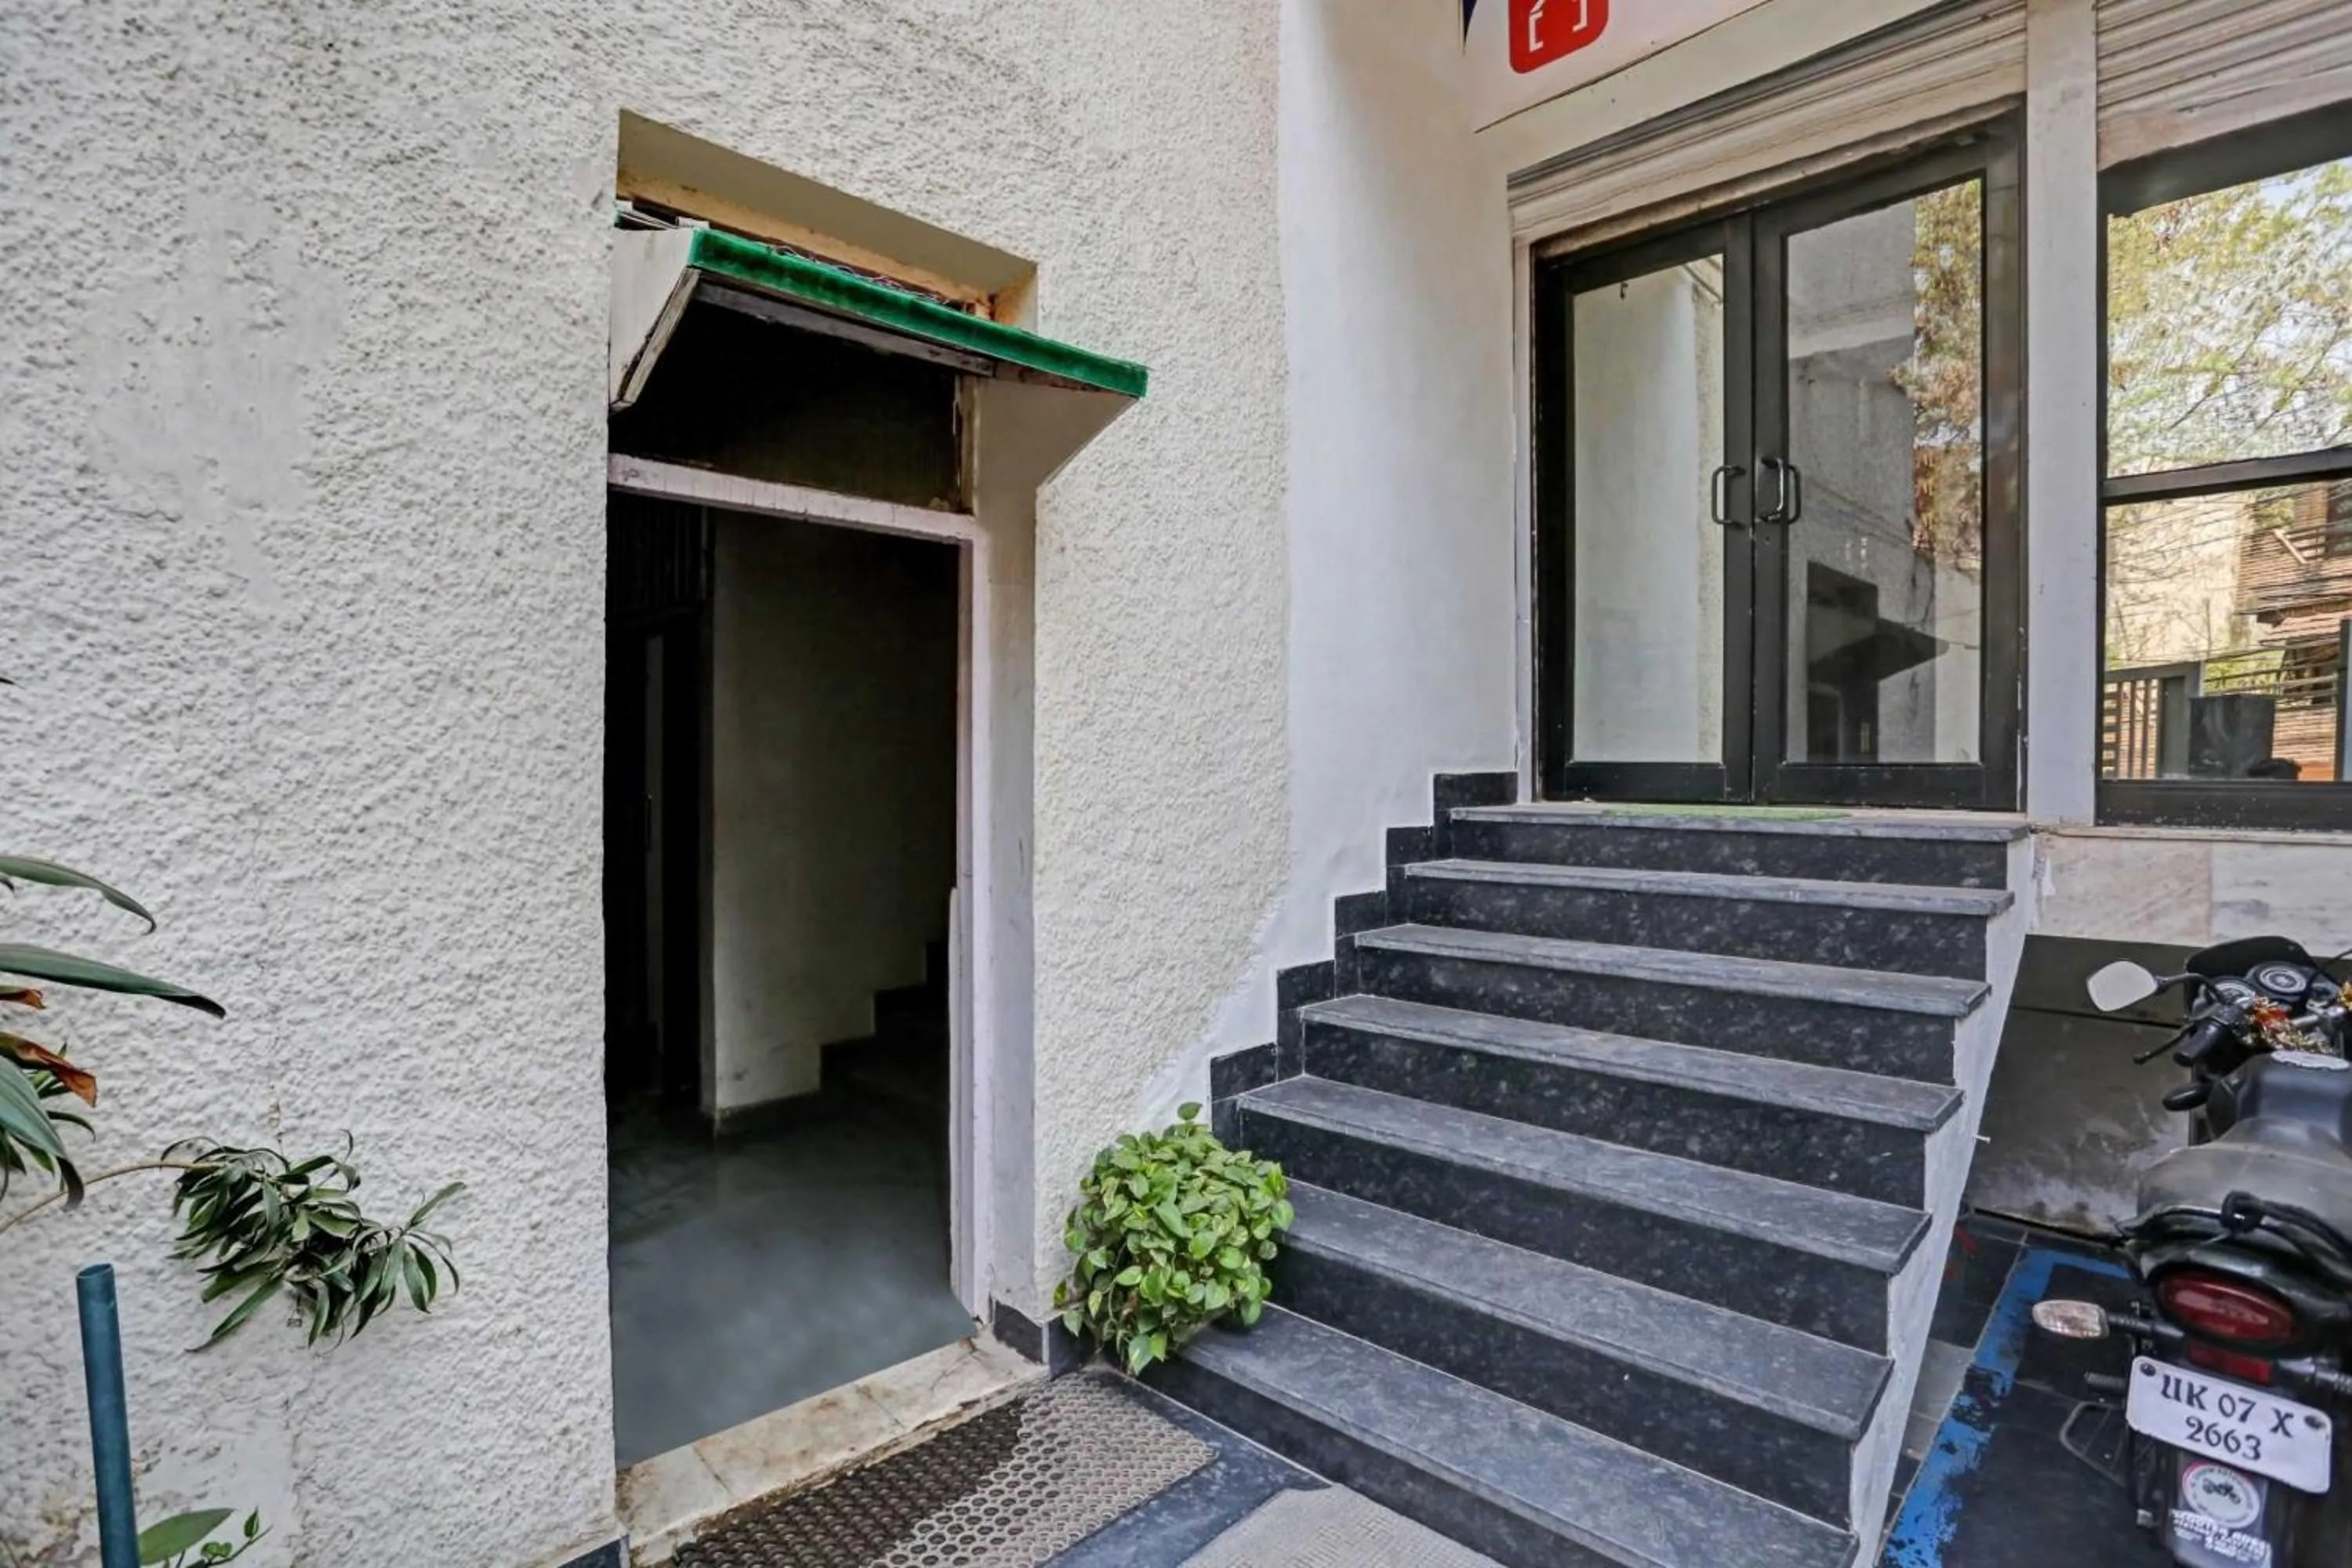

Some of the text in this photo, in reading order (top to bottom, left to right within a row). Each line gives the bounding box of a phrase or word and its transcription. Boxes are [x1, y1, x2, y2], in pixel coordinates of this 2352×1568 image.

[2161, 1374, 2294, 1439] UK 07 X
[2185, 1416, 2262, 1461] 2663
